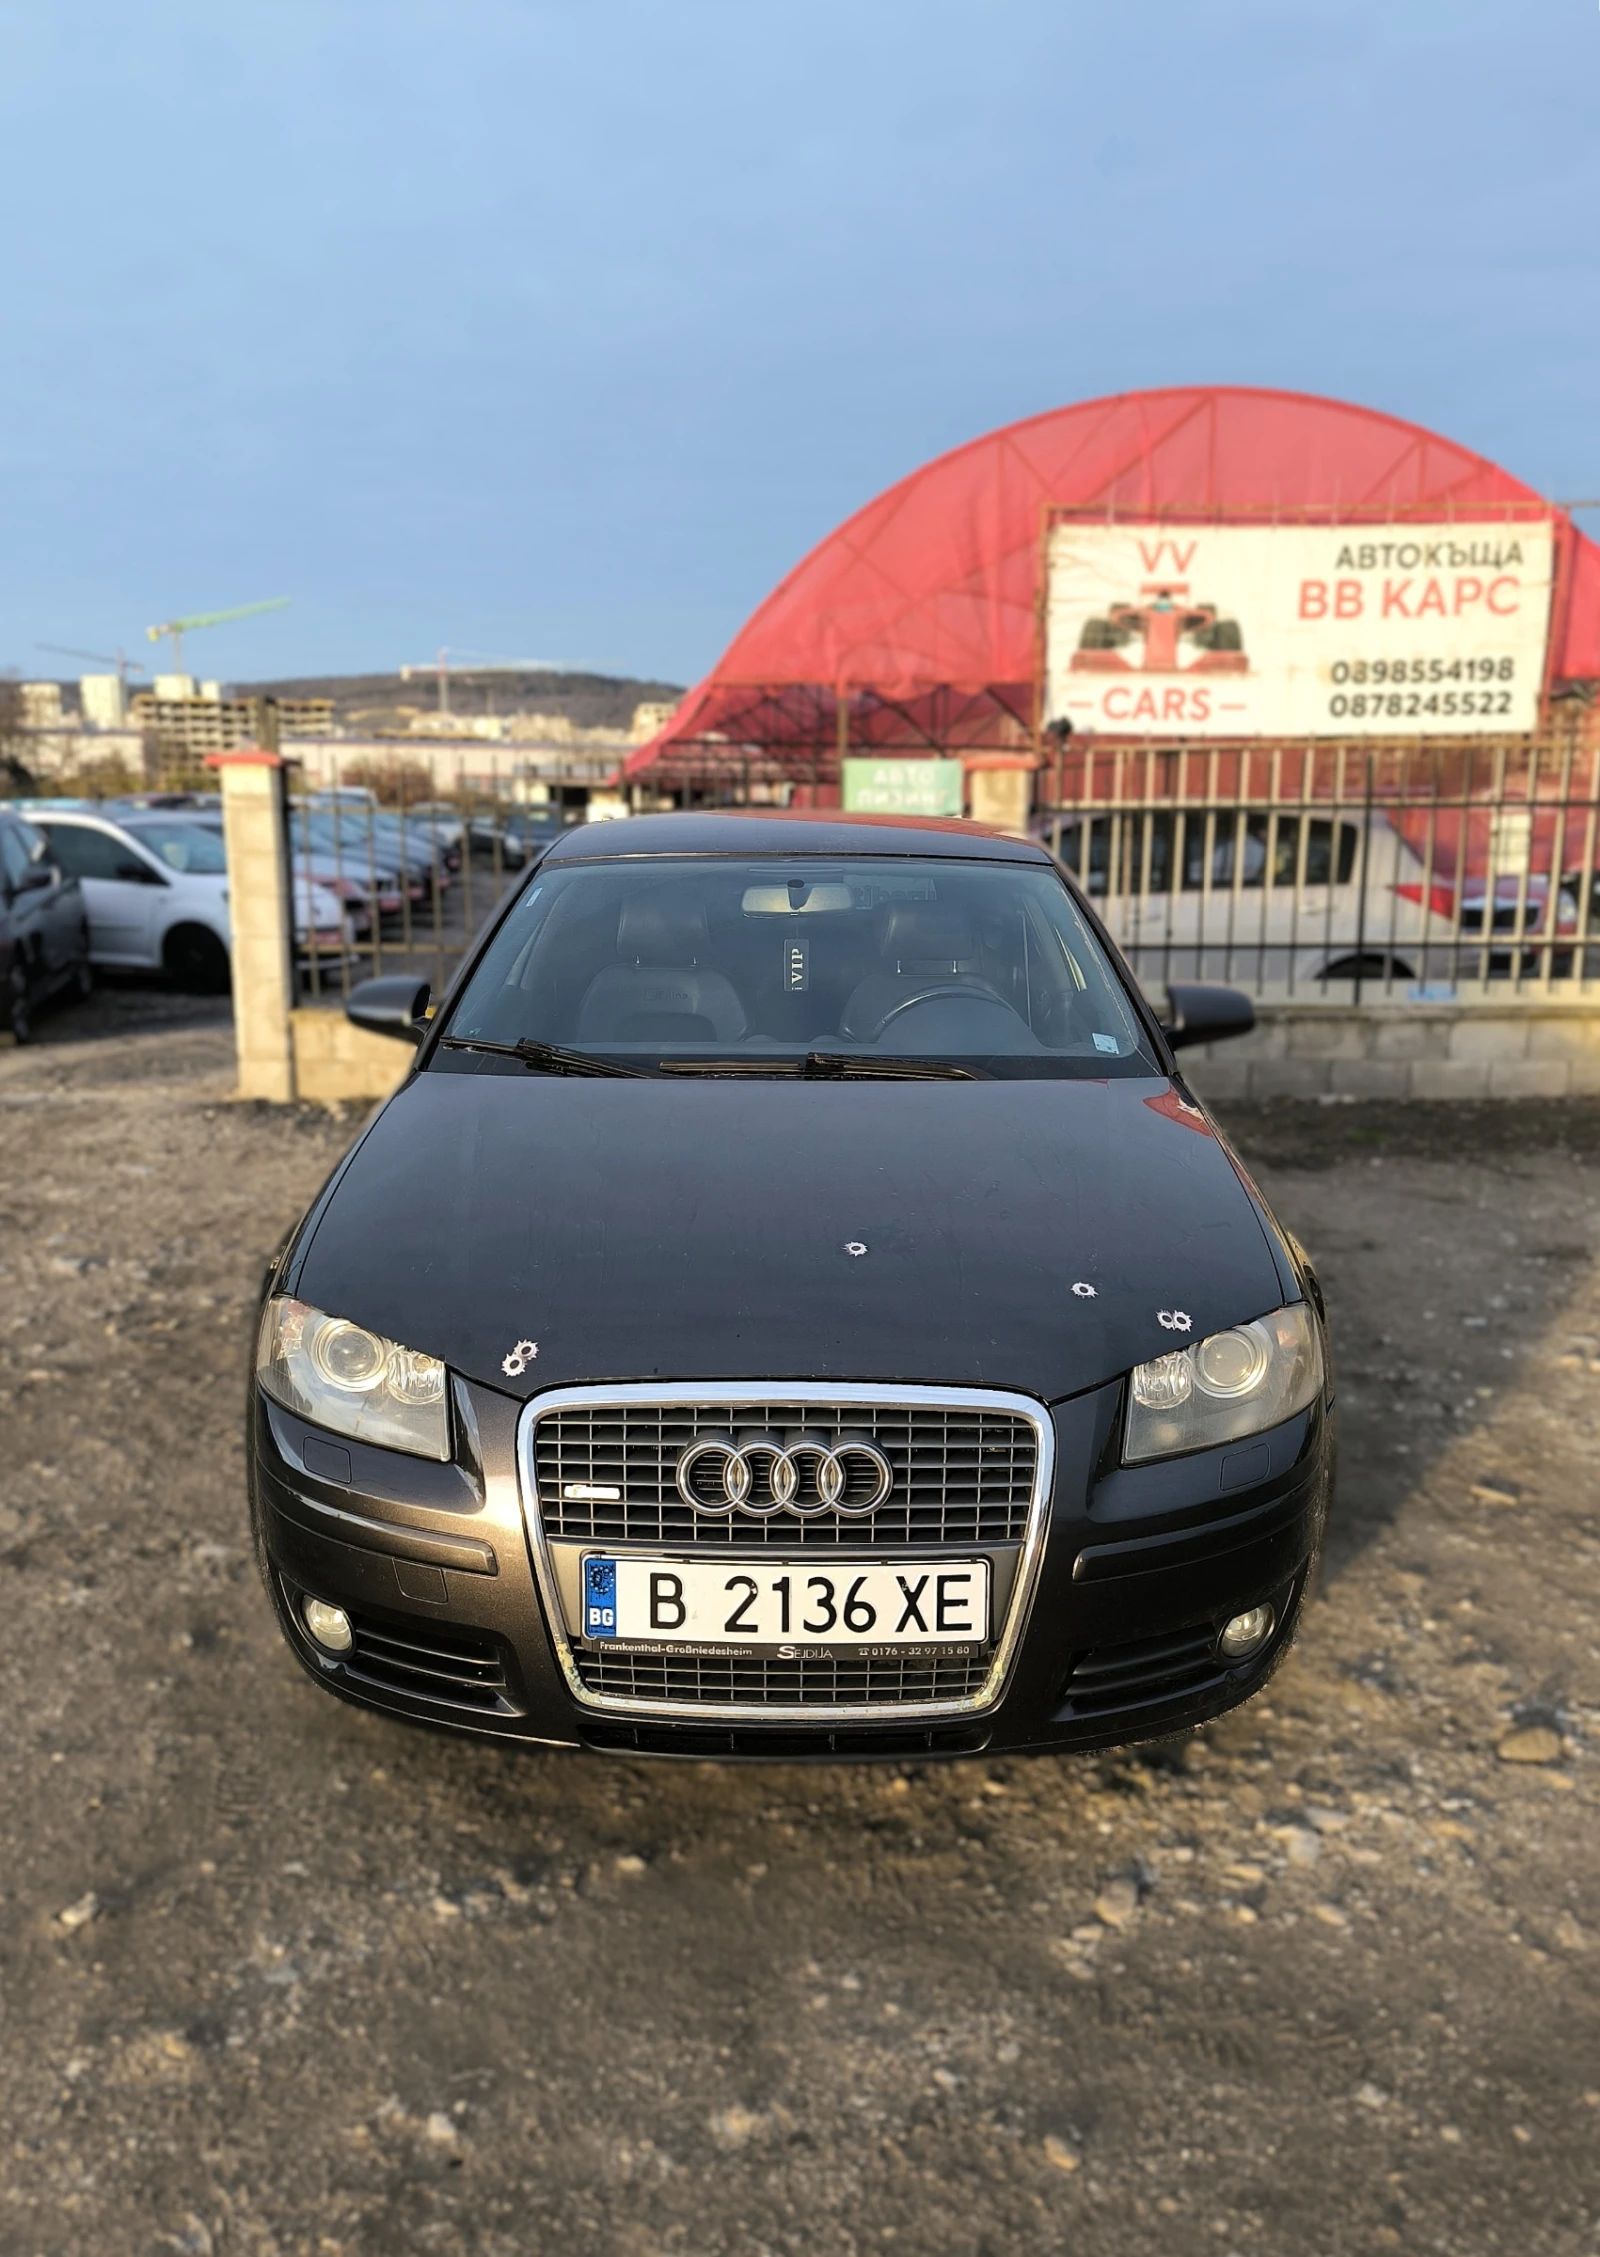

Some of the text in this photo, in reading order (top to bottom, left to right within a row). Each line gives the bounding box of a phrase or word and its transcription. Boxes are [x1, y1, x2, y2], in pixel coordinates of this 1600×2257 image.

[1137, 540, 1199, 575] VV
[1336, 542, 1525, 572] АВТОКЪЩА
[1299, 576, 1523, 621] ВВ КАРС
[1331, 658, 1515, 686] 0898554198
[1103, 687, 1212, 723] CARS
[1330, 691, 1513, 719] 0878245522
[590, 1608, 614, 1627] BG
[650, 1573, 974, 1634] B 2136 XE
[600, 1641, 753, 1656] Frankenthal-Großniedesheim
[871, 1648, 898, 1656] 0176
[908, 1647, 922, 1656] 32
[924, 1647, 938, 1655] 97
[941, 1647, 954, 1655] 15
[956, 1646, 970, 1655] 80
